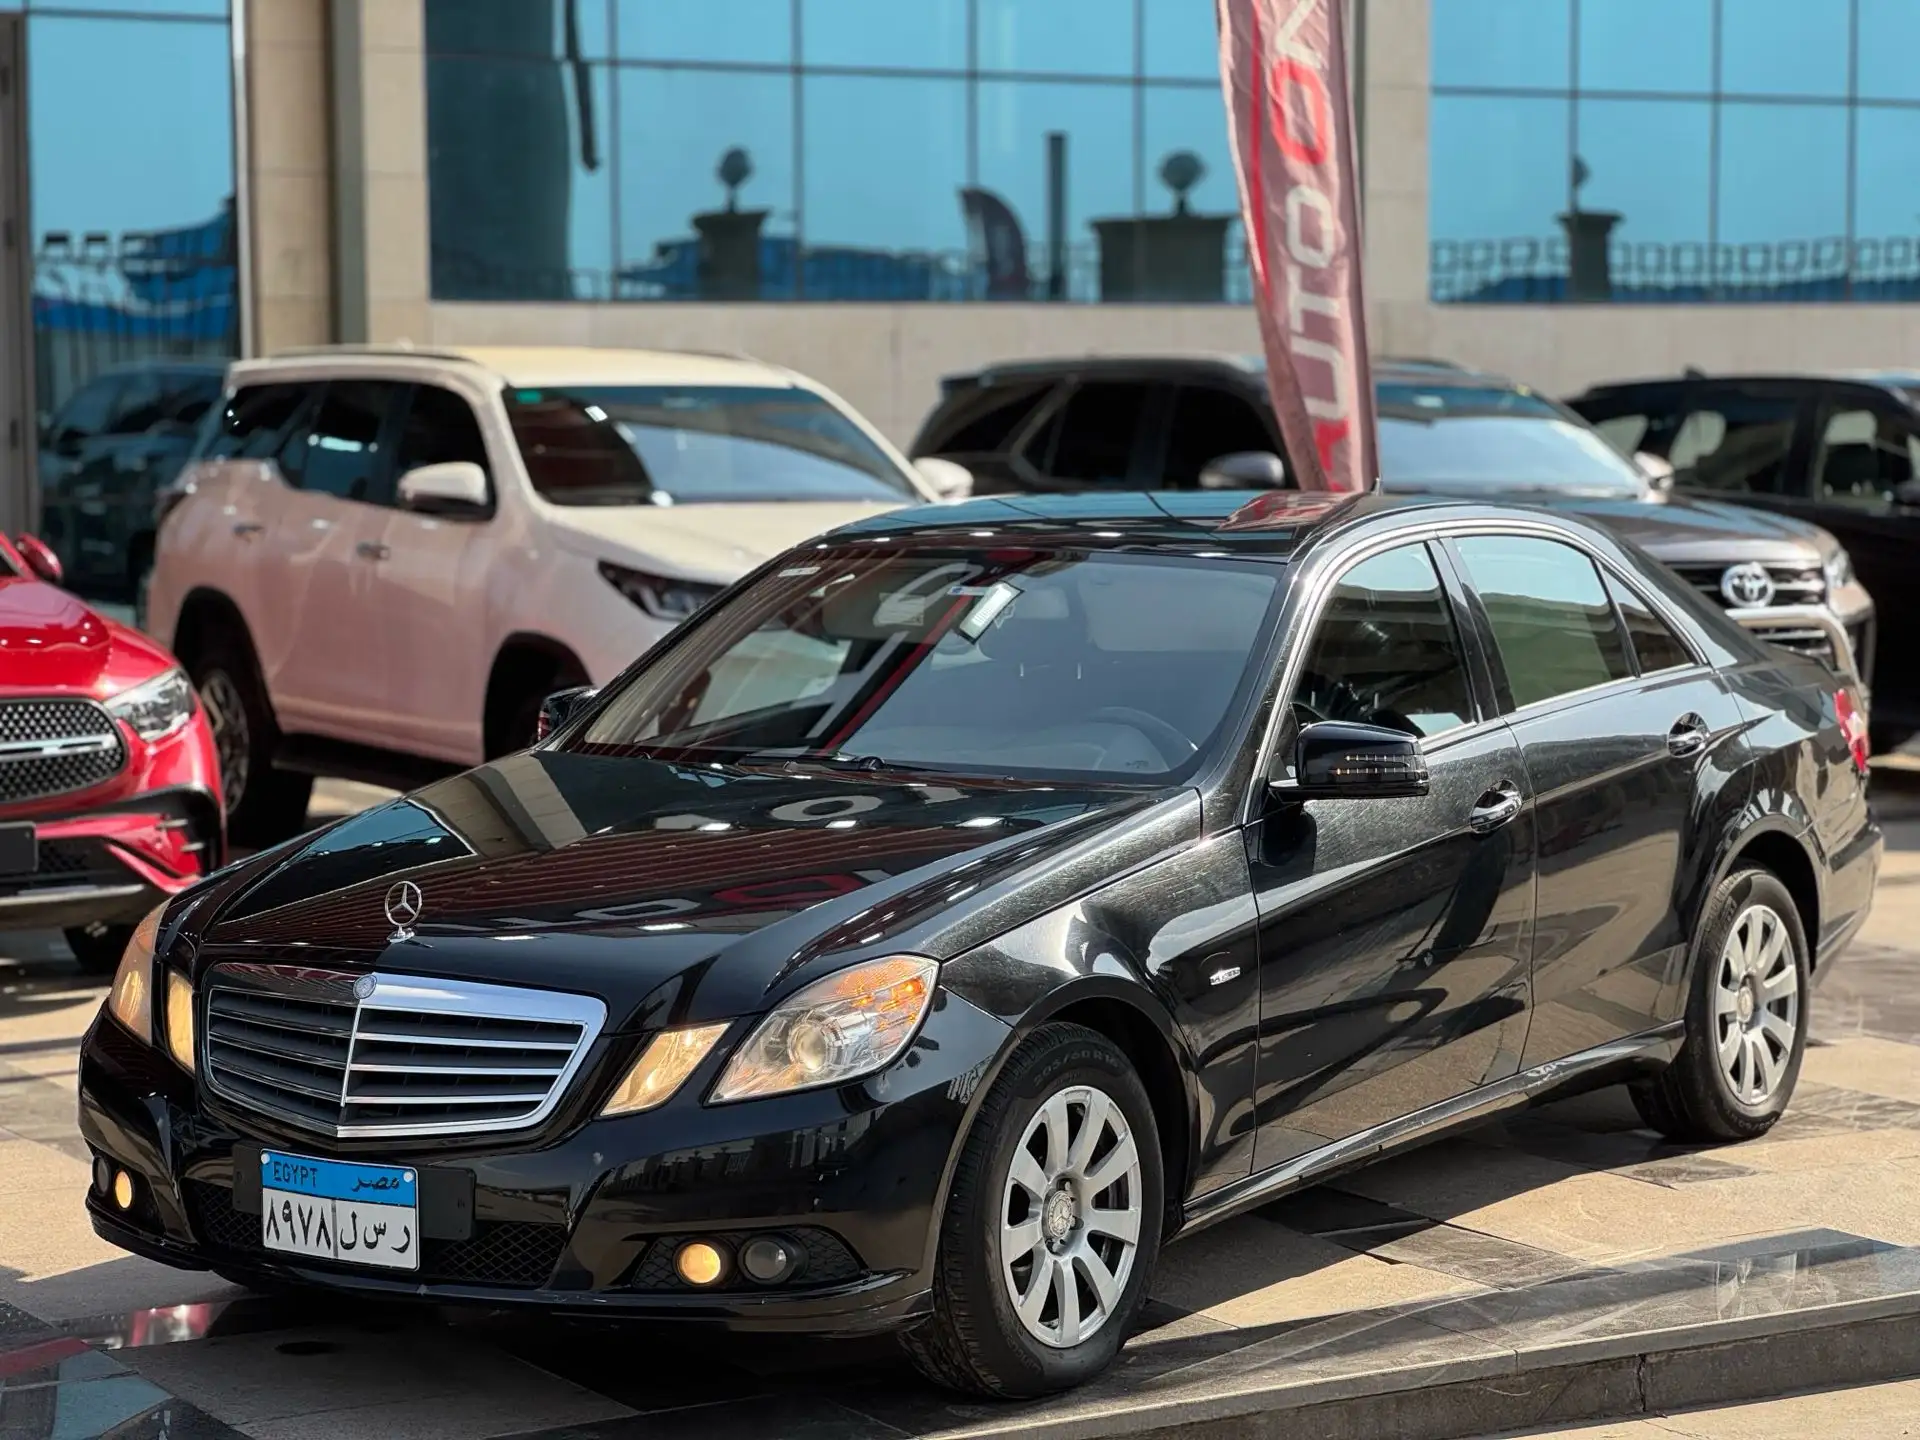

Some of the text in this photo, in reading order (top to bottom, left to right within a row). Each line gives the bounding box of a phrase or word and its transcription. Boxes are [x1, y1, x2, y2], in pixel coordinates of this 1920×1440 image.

[273, 1161, 318, 1187] EGYPT
[351, 1176, 400, 1192] مصر
[266, 1196, 332, 1250] ٨٩٧٨
